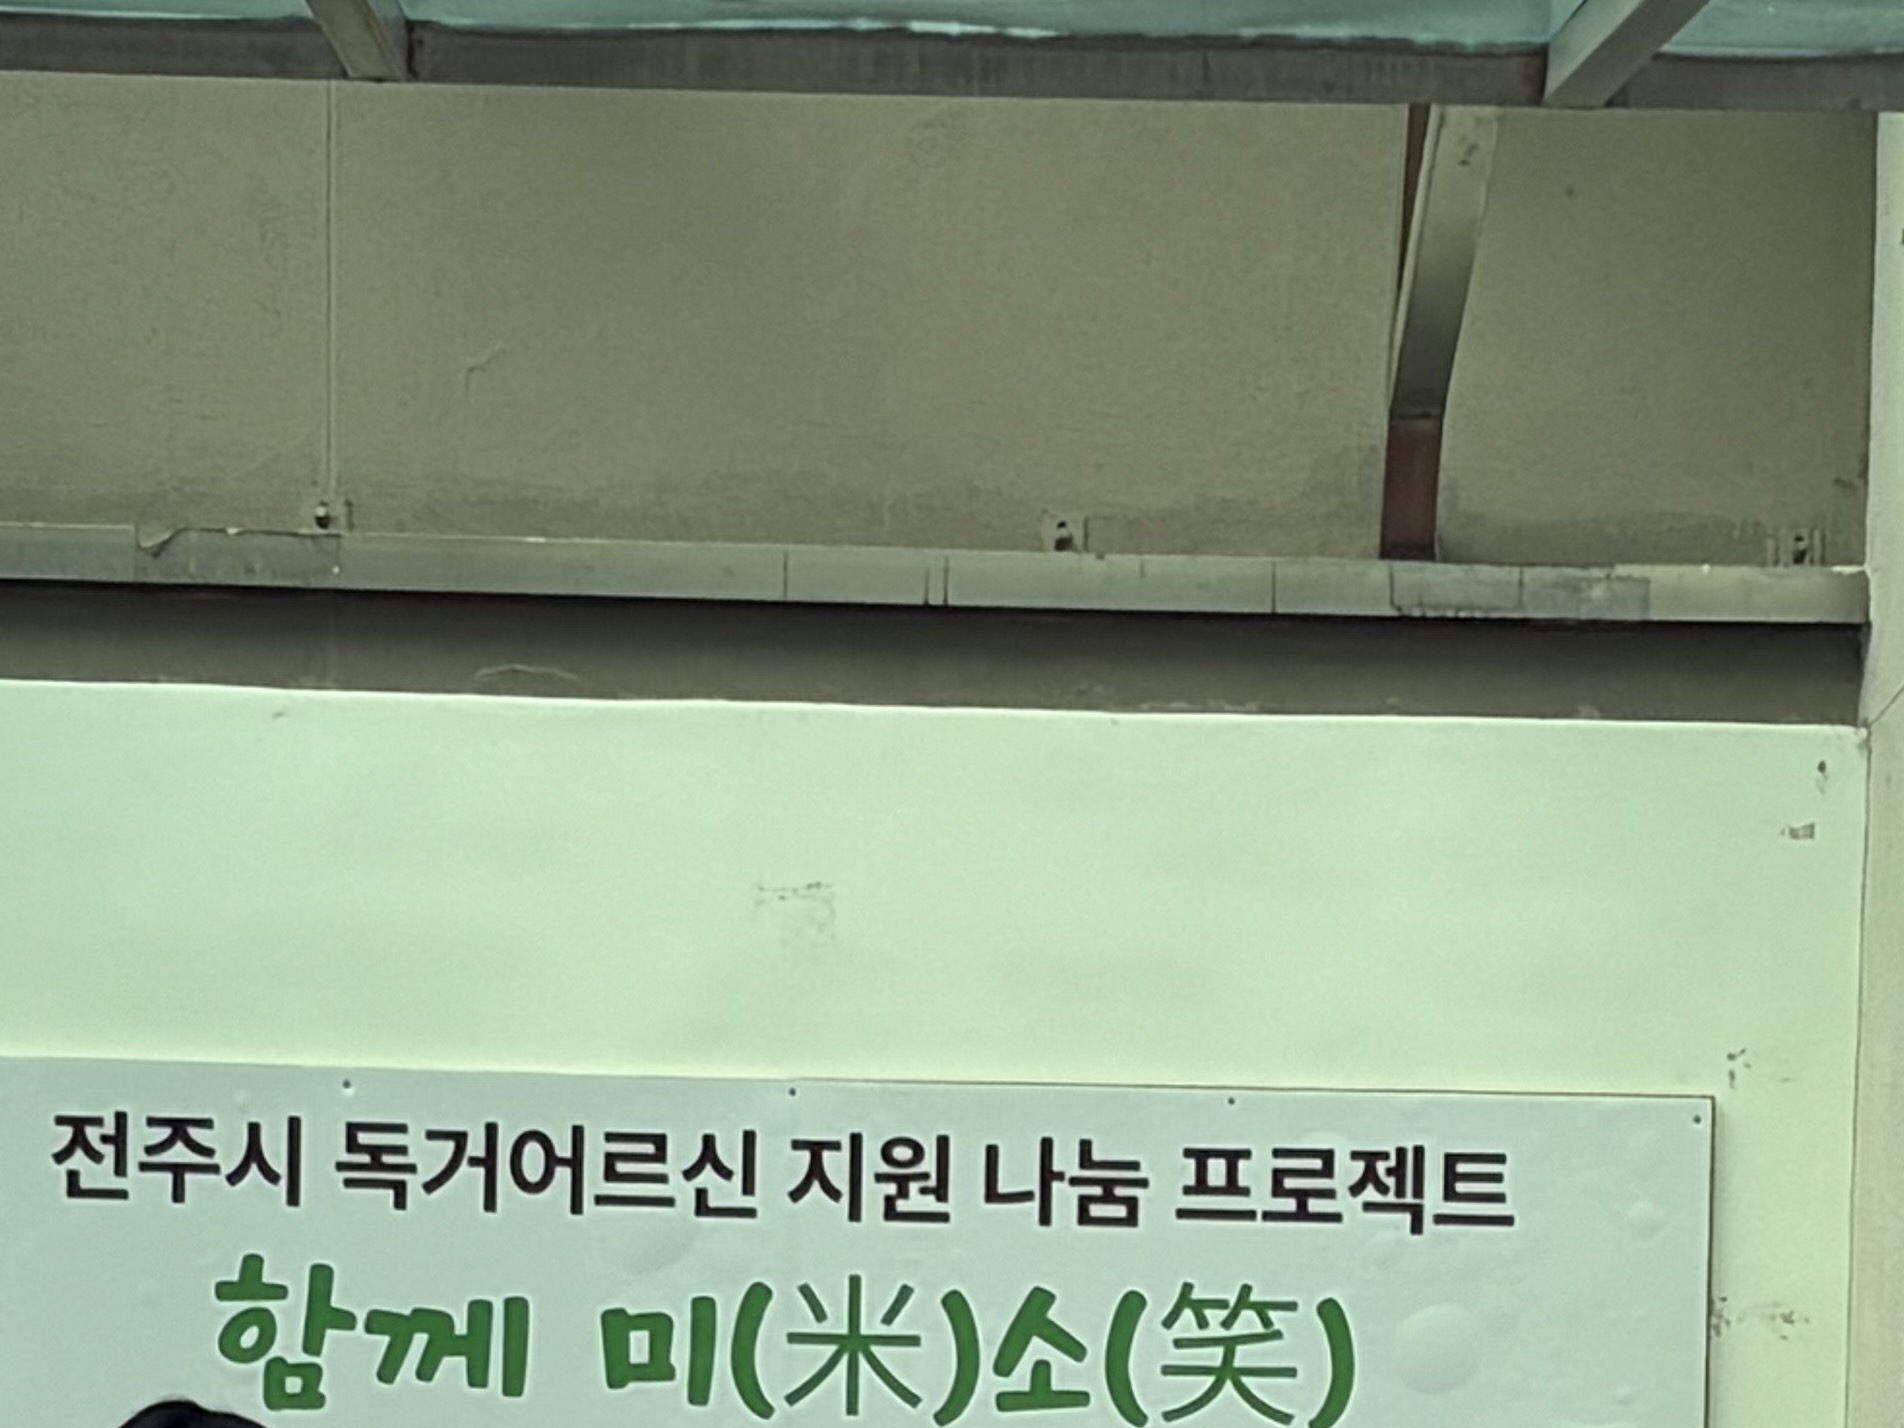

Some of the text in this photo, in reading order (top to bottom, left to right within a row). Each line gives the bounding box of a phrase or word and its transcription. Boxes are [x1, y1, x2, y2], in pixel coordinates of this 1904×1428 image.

[51, 1111, 1515, 1235] 전주시 독거어르신 지원 나눔 프로젝트
[214, 1253, 530, 1410] 함께
